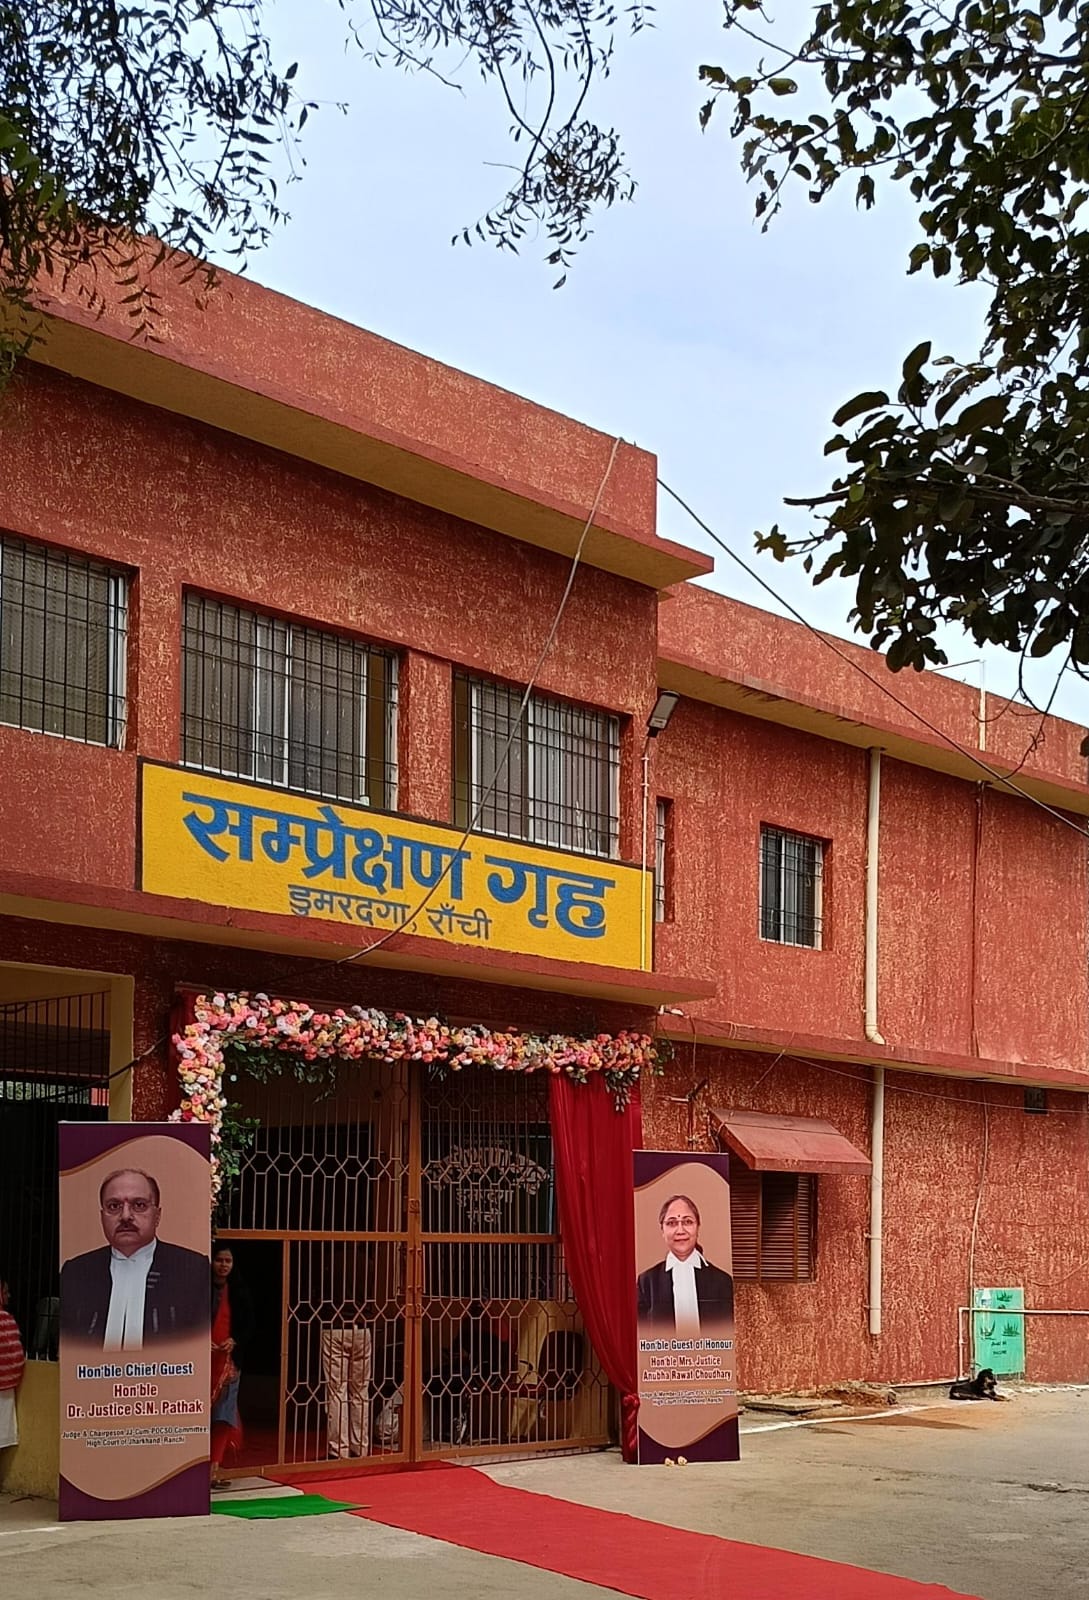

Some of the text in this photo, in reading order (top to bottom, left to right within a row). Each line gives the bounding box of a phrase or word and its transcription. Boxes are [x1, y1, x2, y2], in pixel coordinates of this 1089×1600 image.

[182, 791, 615, 939] सम्प्रेक्षण गृह
[426, 902, 493, 940] राँची
[640, 1339, 733, 1351] Hon'ble Guest of Honour
[696, 1355, 721, 1366] Justice
[78, 1362, 193, 1379] Hon'ble Chief Guest
[643, 1368, 732, 1381] Anubha Rawat Choudhary
[113, 1384, 158, 1397] Hon'ble
[68, 1400, 203, 1418] Dr. Justice S.N. Pathak
[63, 1430, 81, 1439] Judge
[86, 1439, 101, 1447] High
[102, 1438, 119, 1446] Court
[163, 1436, 185, 1444] Ranchi
